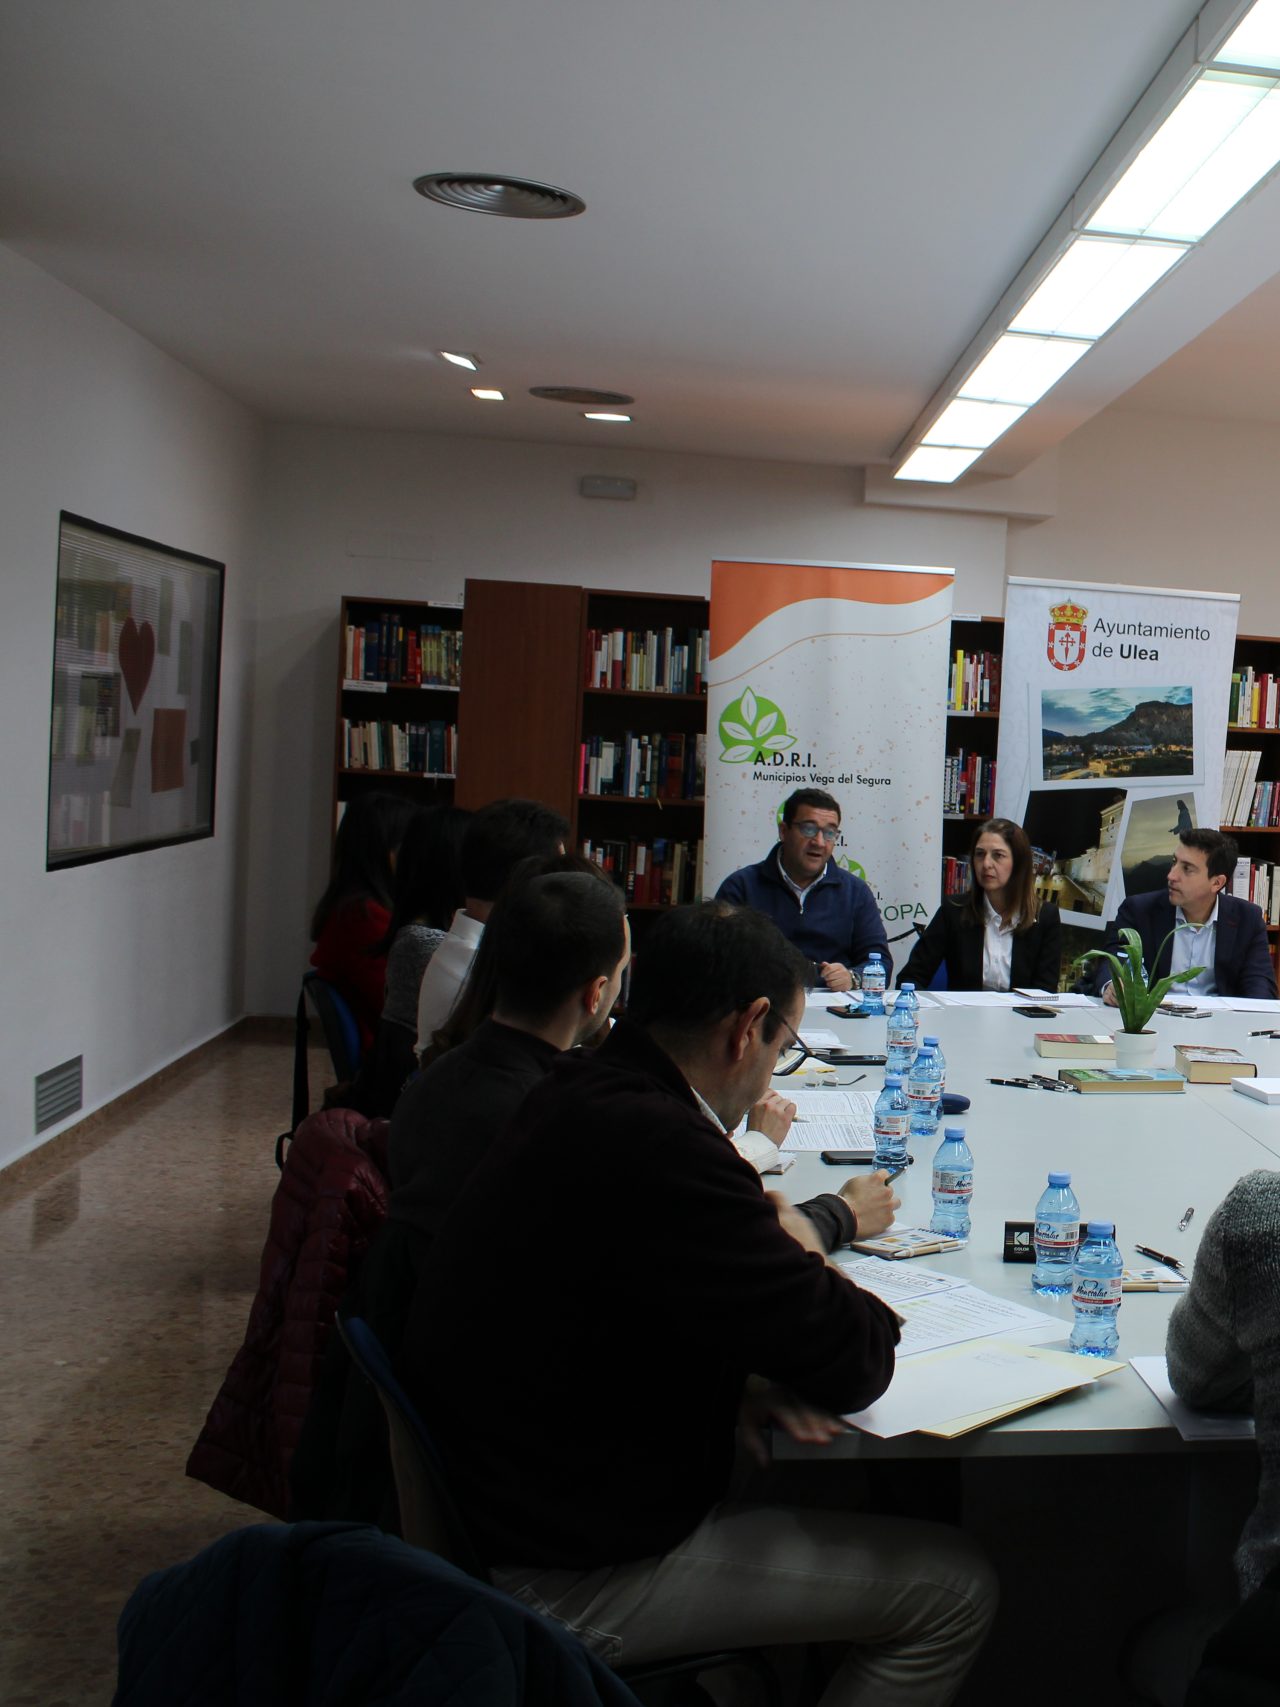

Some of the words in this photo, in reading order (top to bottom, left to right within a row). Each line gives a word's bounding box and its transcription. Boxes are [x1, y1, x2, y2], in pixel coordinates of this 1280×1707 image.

[1093, 618, 1211, 641] Ayuntamiento
[1092, 642, 1113, 658] de
[1119, 643, 1159, 661] Ulea
[753, 750, 817, 768] A.D.R.I.
[753, 771, 807, 785] Municipios
[809, 773, 835, 786] Vega
[837, 773, 853, 784] del
[856, 775, 891, 787] Segura
[880, 902, 928, 922] OPA
